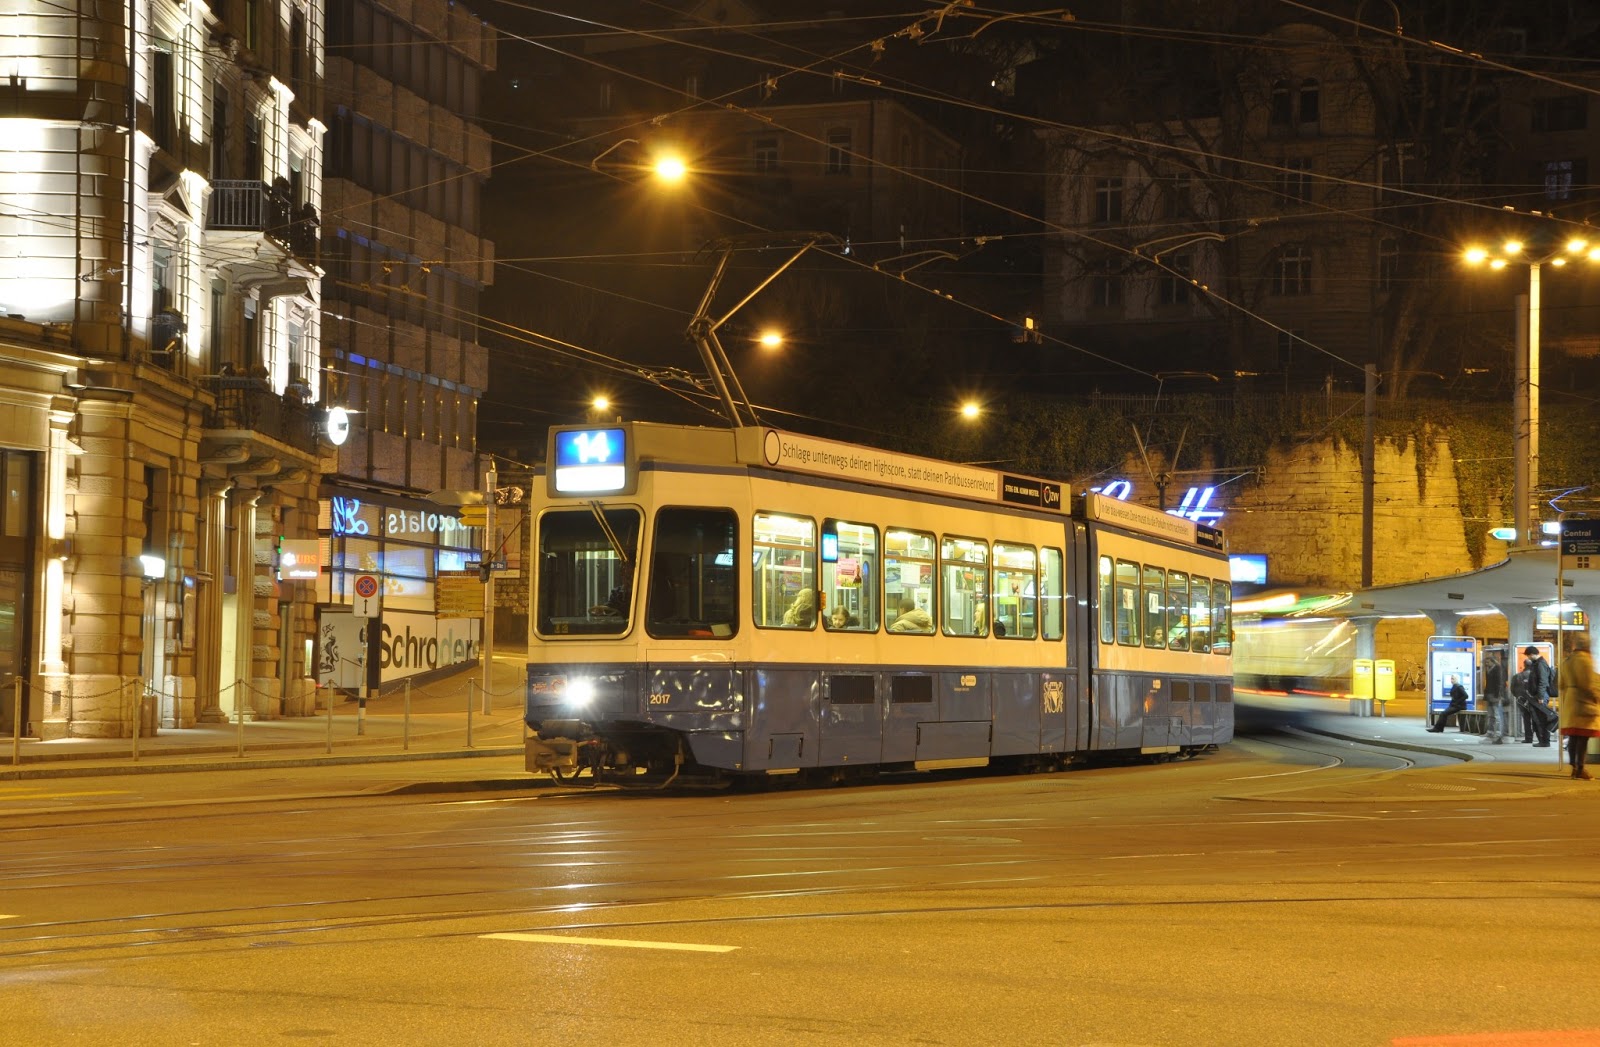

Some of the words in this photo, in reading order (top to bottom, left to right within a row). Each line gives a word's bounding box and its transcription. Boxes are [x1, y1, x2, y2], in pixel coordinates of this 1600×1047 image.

[573, 431, 611, 464] 14
[782, 442, 811, 464] Schlage
[812, 450, 848, 470] unterwegs
[849, 454, 873, 473] deinen
[873, 458, 907, 479] Highscore,
[907, 466, 922, 481] statt
[922, 469, 944, 484] deinen
[1569, 543, 1577, 553] 3
[297, 554, 317, 565] UBS
[650, 694, 671, 705] 2017
